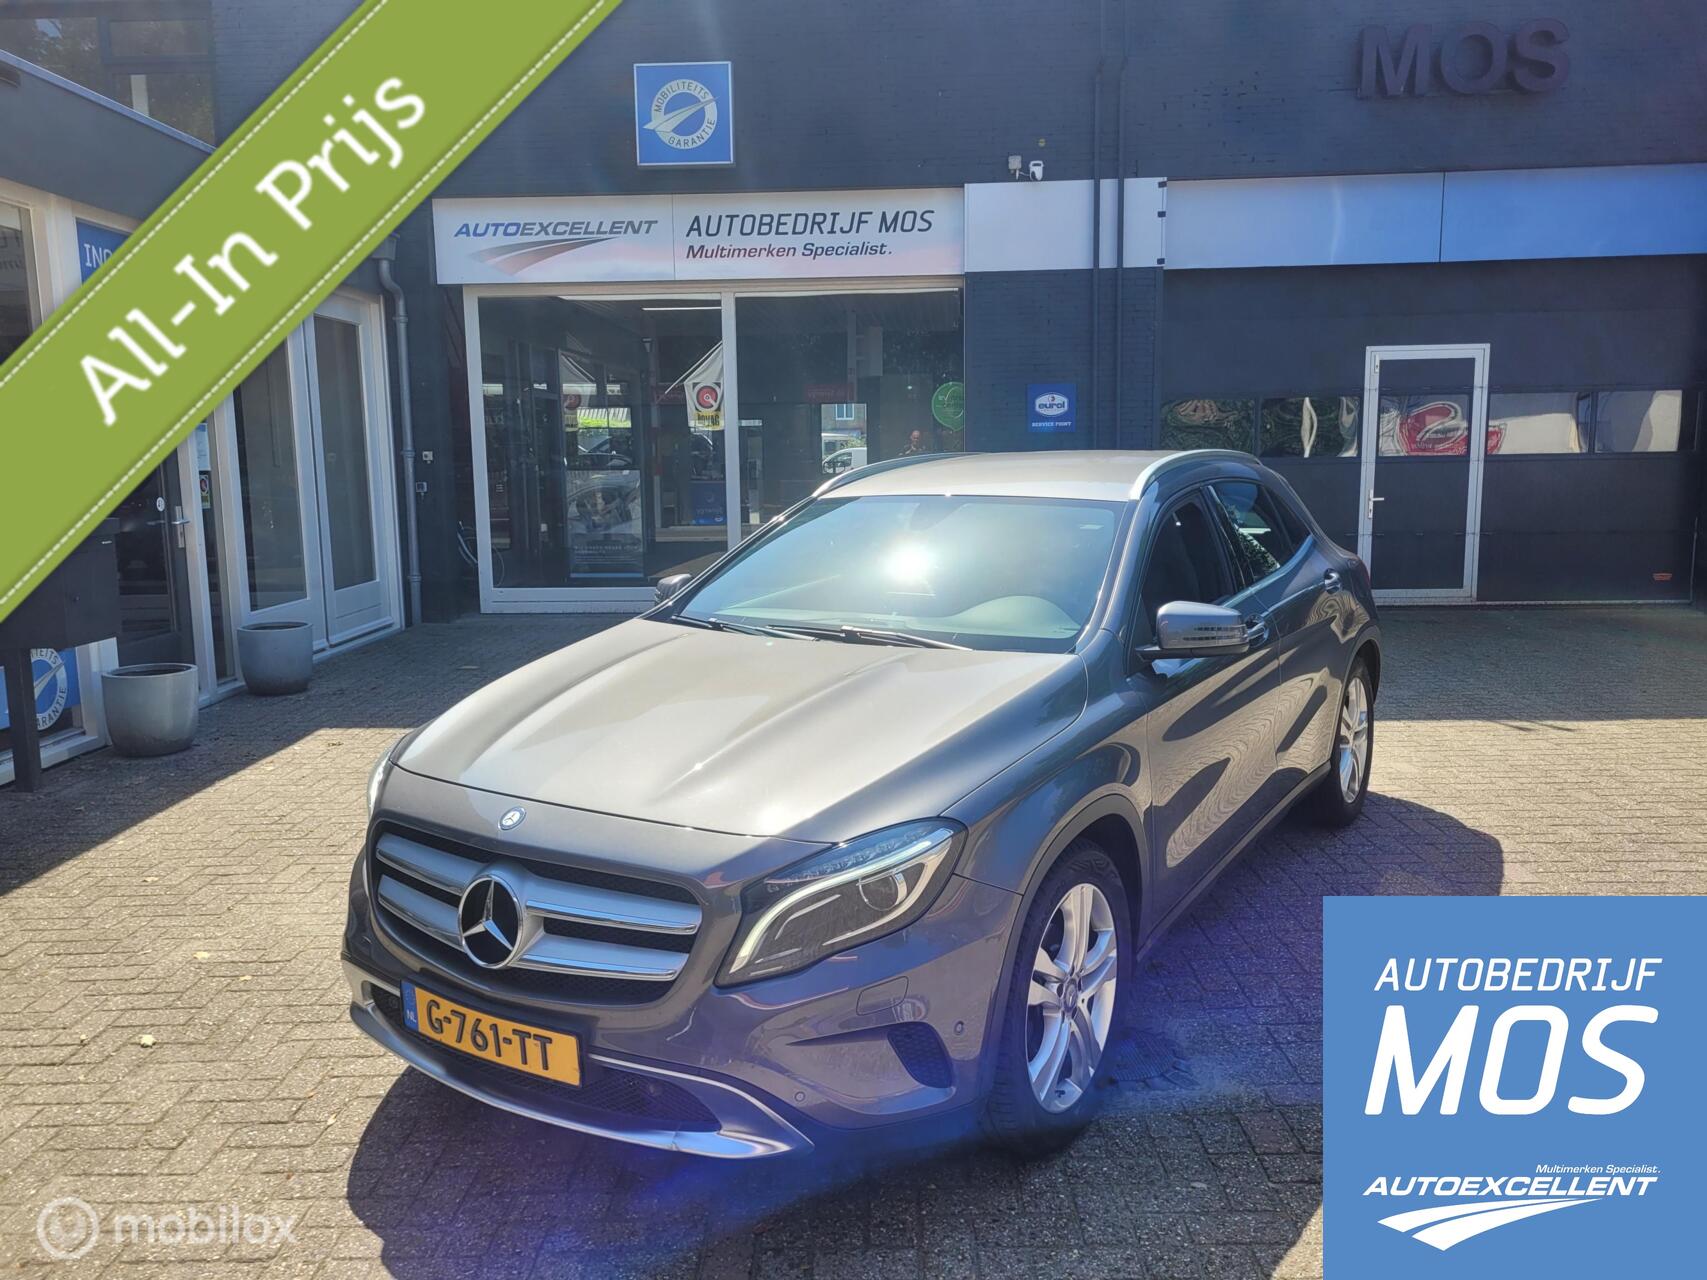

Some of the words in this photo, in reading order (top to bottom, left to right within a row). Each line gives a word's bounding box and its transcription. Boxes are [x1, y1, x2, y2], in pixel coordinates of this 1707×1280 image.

[1358, 17, 1570, 99] MOS
[653, 80, 710, 113] MOBILITEITS
[668, 118, 716, 148] GARANTIE
[454, 220, 658, 238] AUTOEXCELLENT
[686, 210, 873, 238] AUTOBEDRIJF
[878, 209, 934, 233] MOS
[686, 244, 797, 260] Multimerken
[801, 241, 893, 261] Specialist.
[1038, 400, 1065, 409] eurol
[406, 1009, 417, 1023] NL
[426, 999, 553, 1071] G-761-TT
